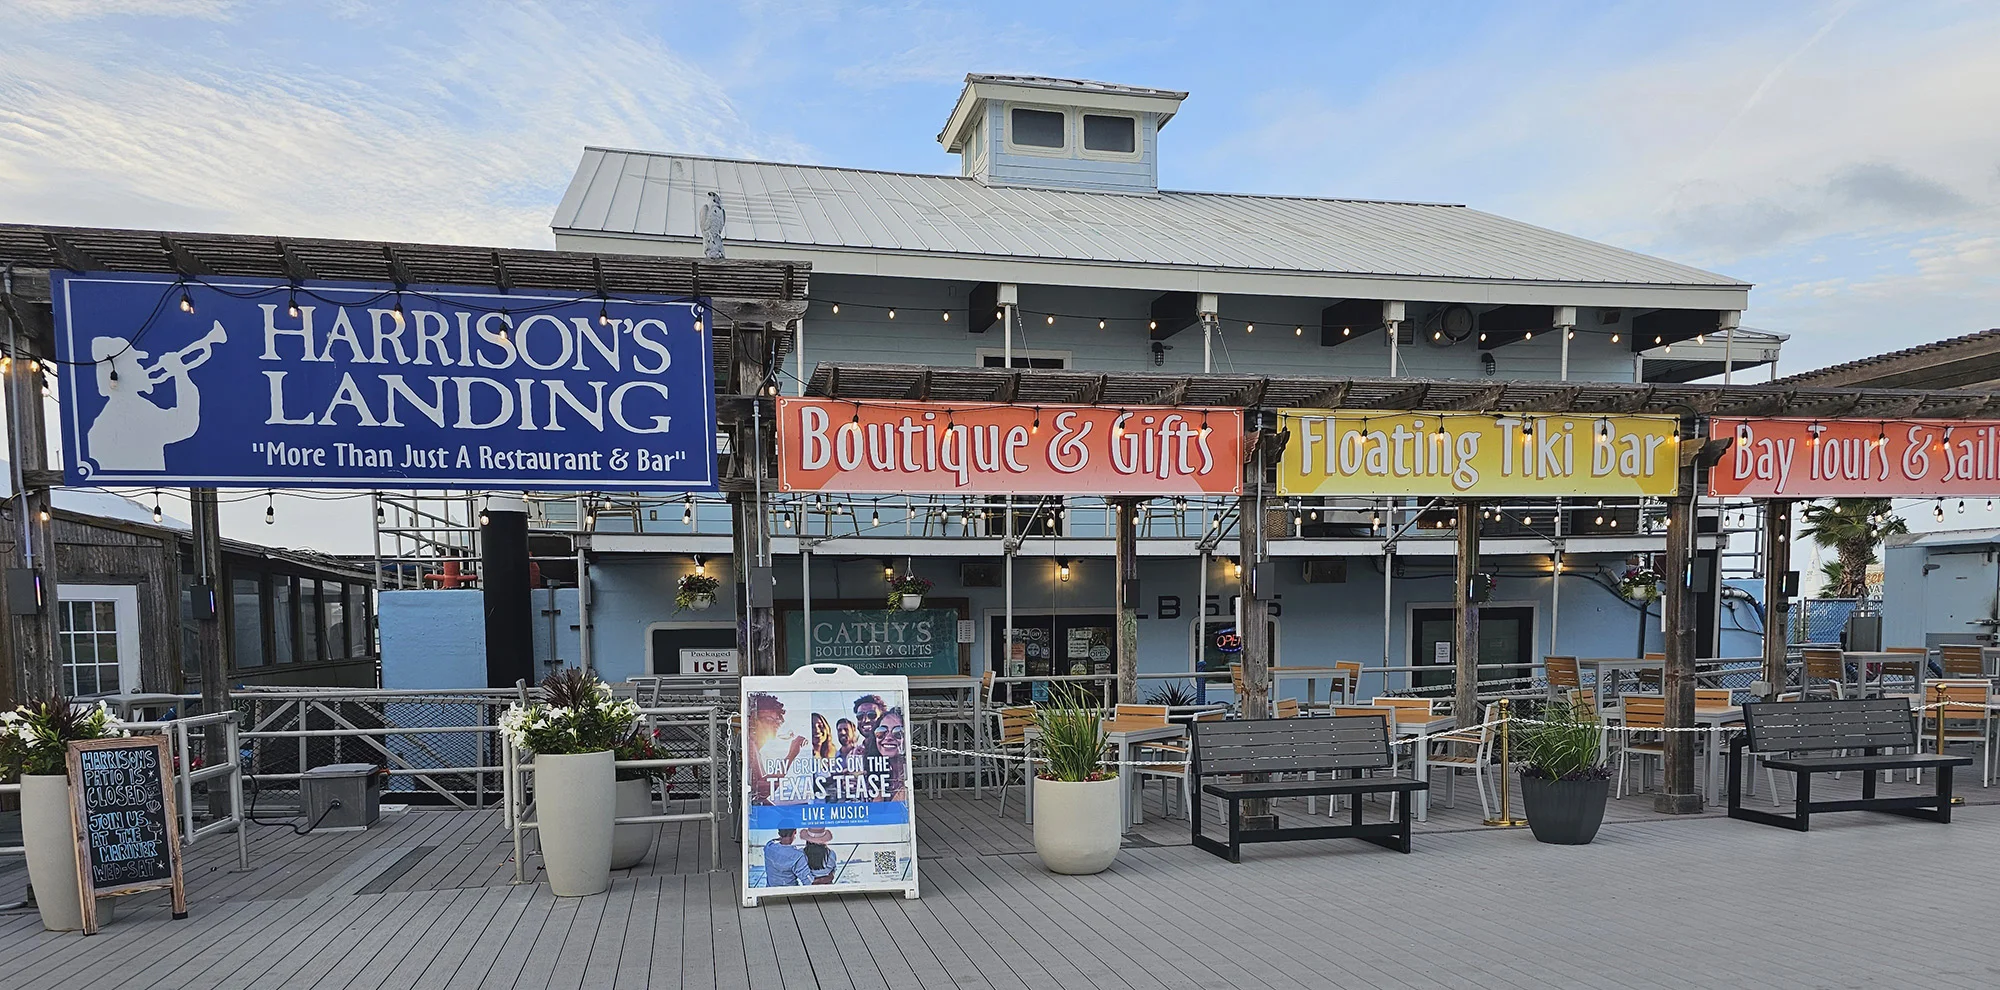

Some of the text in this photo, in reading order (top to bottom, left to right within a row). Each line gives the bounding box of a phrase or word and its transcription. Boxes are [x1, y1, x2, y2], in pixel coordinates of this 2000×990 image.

[257, 303, 673, 375] HARRISON'S
[262, 370, 672, 435] LANDING
[252, 442, 687, 472] "More Than Just A Restaurant & Bar"
[800, 406, 1214, 487] Boutique & Gifts
[1301, 414, 1667, 491] Floating Tiki Bar
[1734, 423, 1796, 495] Bay
[1807, 424, 1890, 482] Tours
[1901, 425, 1934, 482] &
[813, 621, 932, 645] CATHY'S
[815, 643, 932, 657] BOUTIQUE & GIFTS
[694, 660, 728, 673] ICE
[82, 749, 157, 770] HARRISONS
[767, 755, 890, 775] BAY CRUISES ON THE
[85, 768, 146, 786] PATIO IS
[766, 773, 892, 801] TEXAS TEASE
[86, 784, 148, 808] CLOSED
[88, 810, 149, 832] JOIN US
[802, 805, 869, 821] LIVE MUSIC!
[91, 827, 142, 848] AT THE
[99, 840, 158, 862] MARINER
[93, 858, 156, 882] WED-SAT
